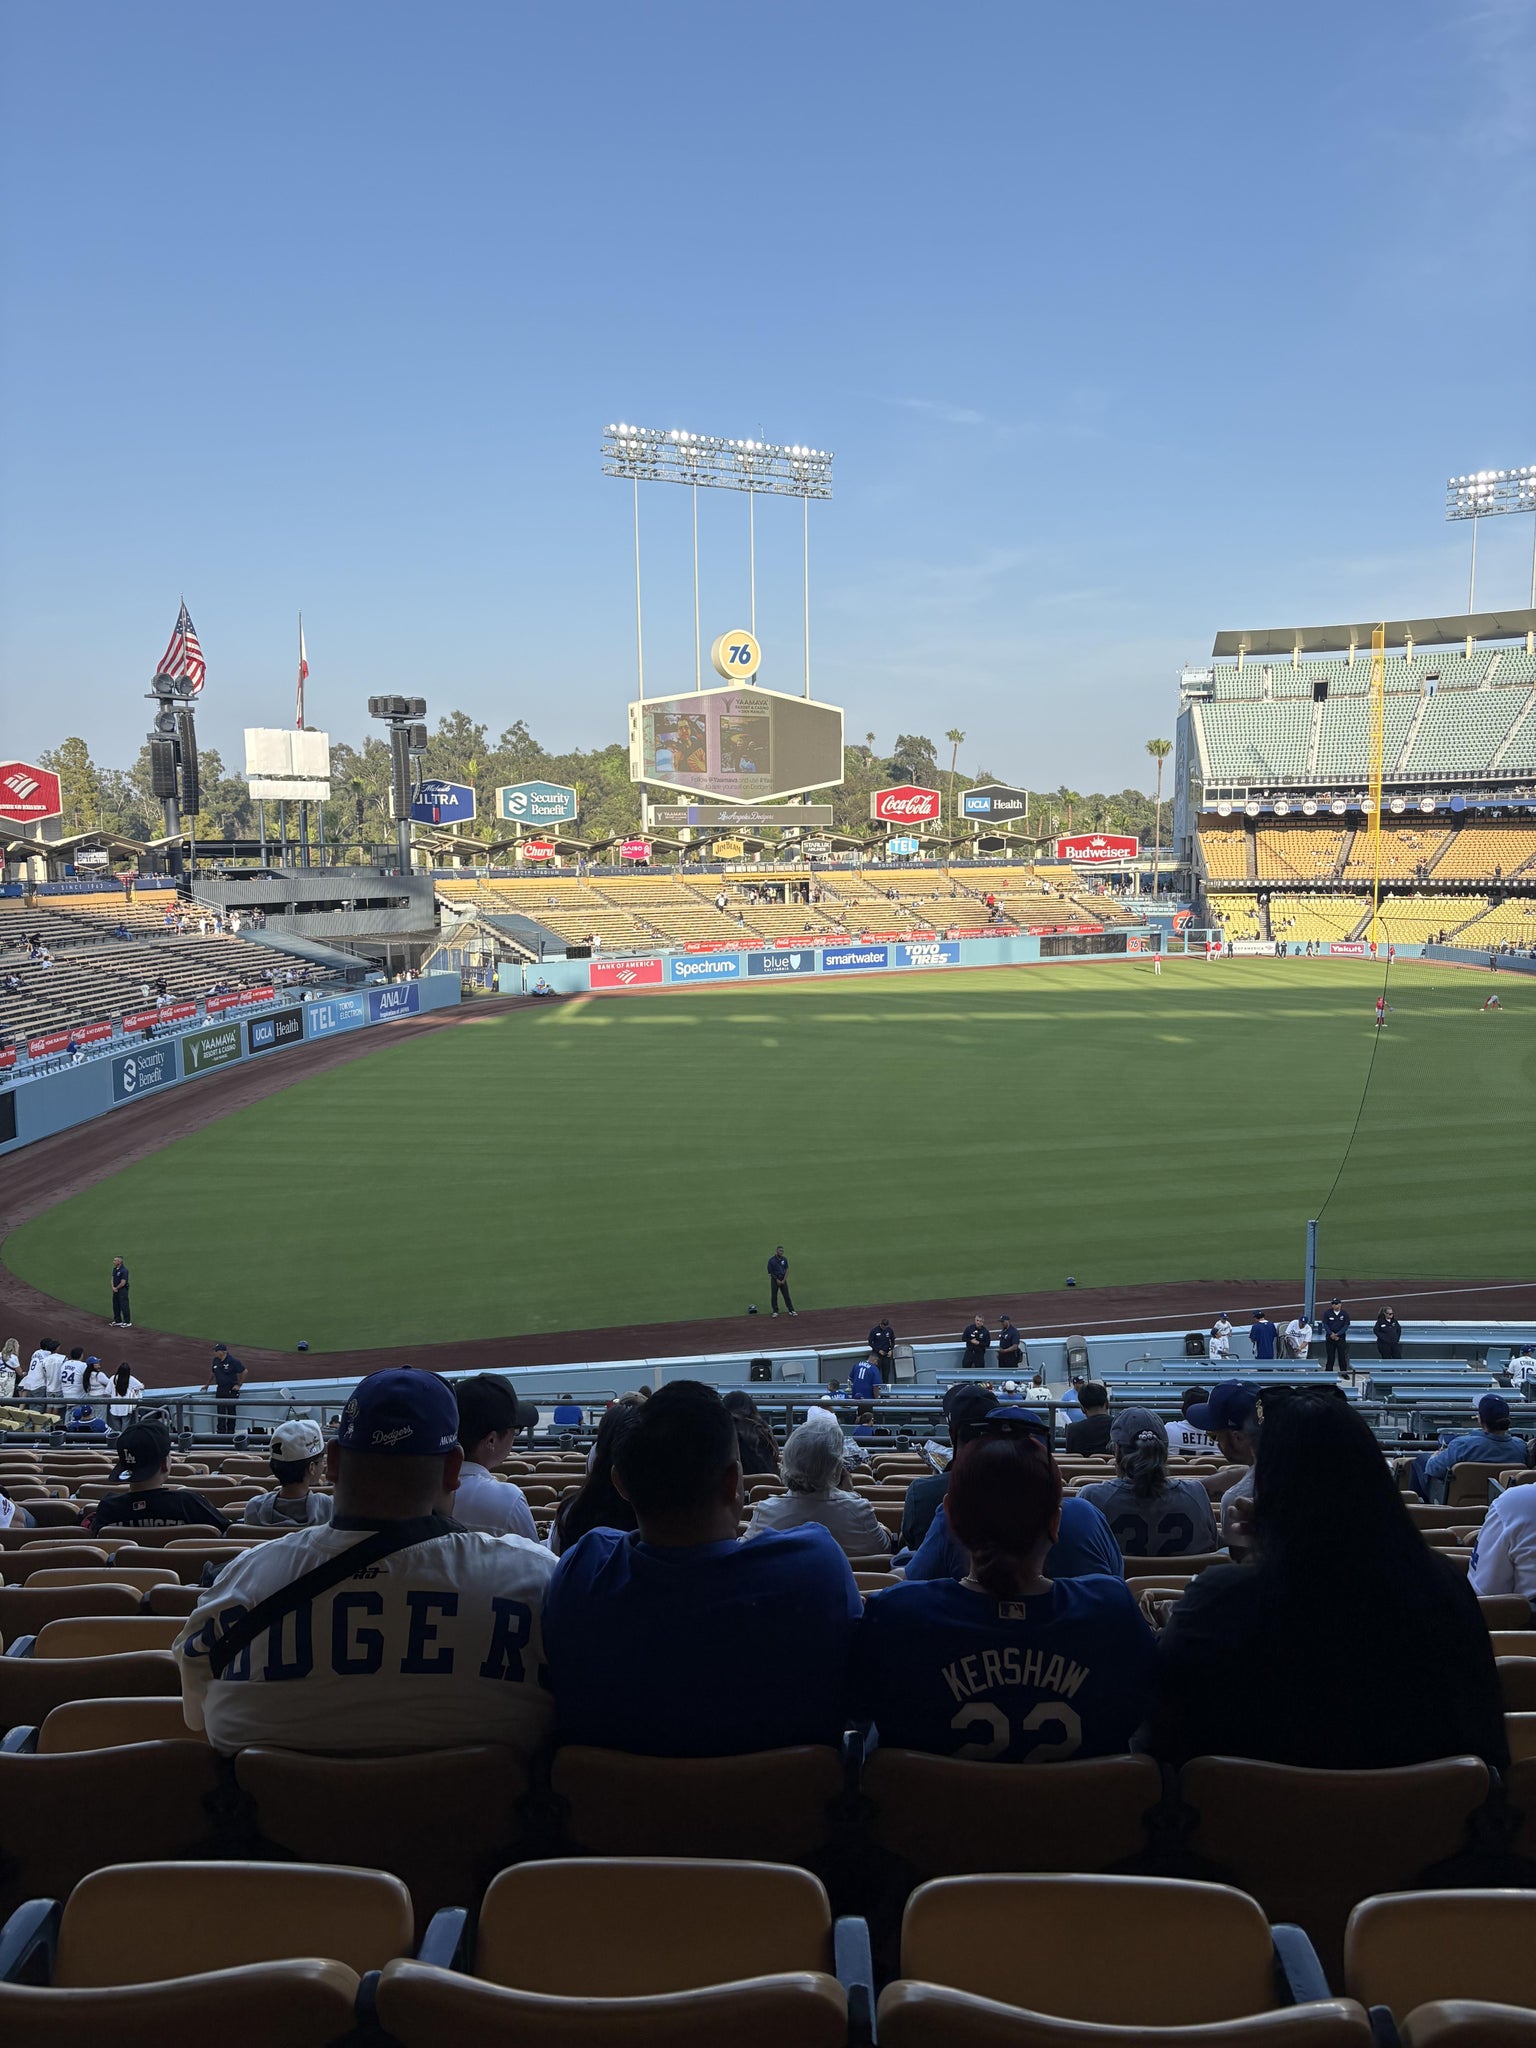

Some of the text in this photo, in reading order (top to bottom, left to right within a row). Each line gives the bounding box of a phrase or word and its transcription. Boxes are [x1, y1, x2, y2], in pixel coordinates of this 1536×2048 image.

[729, 644, 751, 664] 76
[530, 793, 570, 804] Security
[881, 794, 934, 814] Coca-Cola
[531, 804, 565, 815] Benefit
[968, 800, 1023, 810] UCLA Health
[524, 845, 553, 857] Churu
[892, 840, 915, 850] TEL
[1065, 846, 1130, 858] Budweiser
[1177, 916, 1194, 930] 76
[905, 944, 940, 955] TOYO
[1332, 944, 1363, 952] Yakult
[764, 956, 789, 968] blue
[826, 952, 885, 966] smartwater
[911, 954, 948, 965] TIRES
[675, 960, 732, 978] Spectrum
[339, 1000, 354, 1010] TOKYO
[380, 994, 401, 1009] ANA
[310, 1006, 336, 1031] TEL
[340, 1009, 362, 1020] ELECTRON
[255, 1018, 299, 1041] UCLA Health
[203, 1048, 217, 1059] RESORT
[138, 1050, 165, 1071] Security
[139, 1067, 162, 1088] Benefit
[62, 1371, 75, 1384] 24
[858, 1367, 866, 1379] 11
[371, 1425, 413, 1446] Dodgers
[1182, 1432, 1214, 1446] BETTS
[941, 1647, 1090, 1702] KERSHAW
